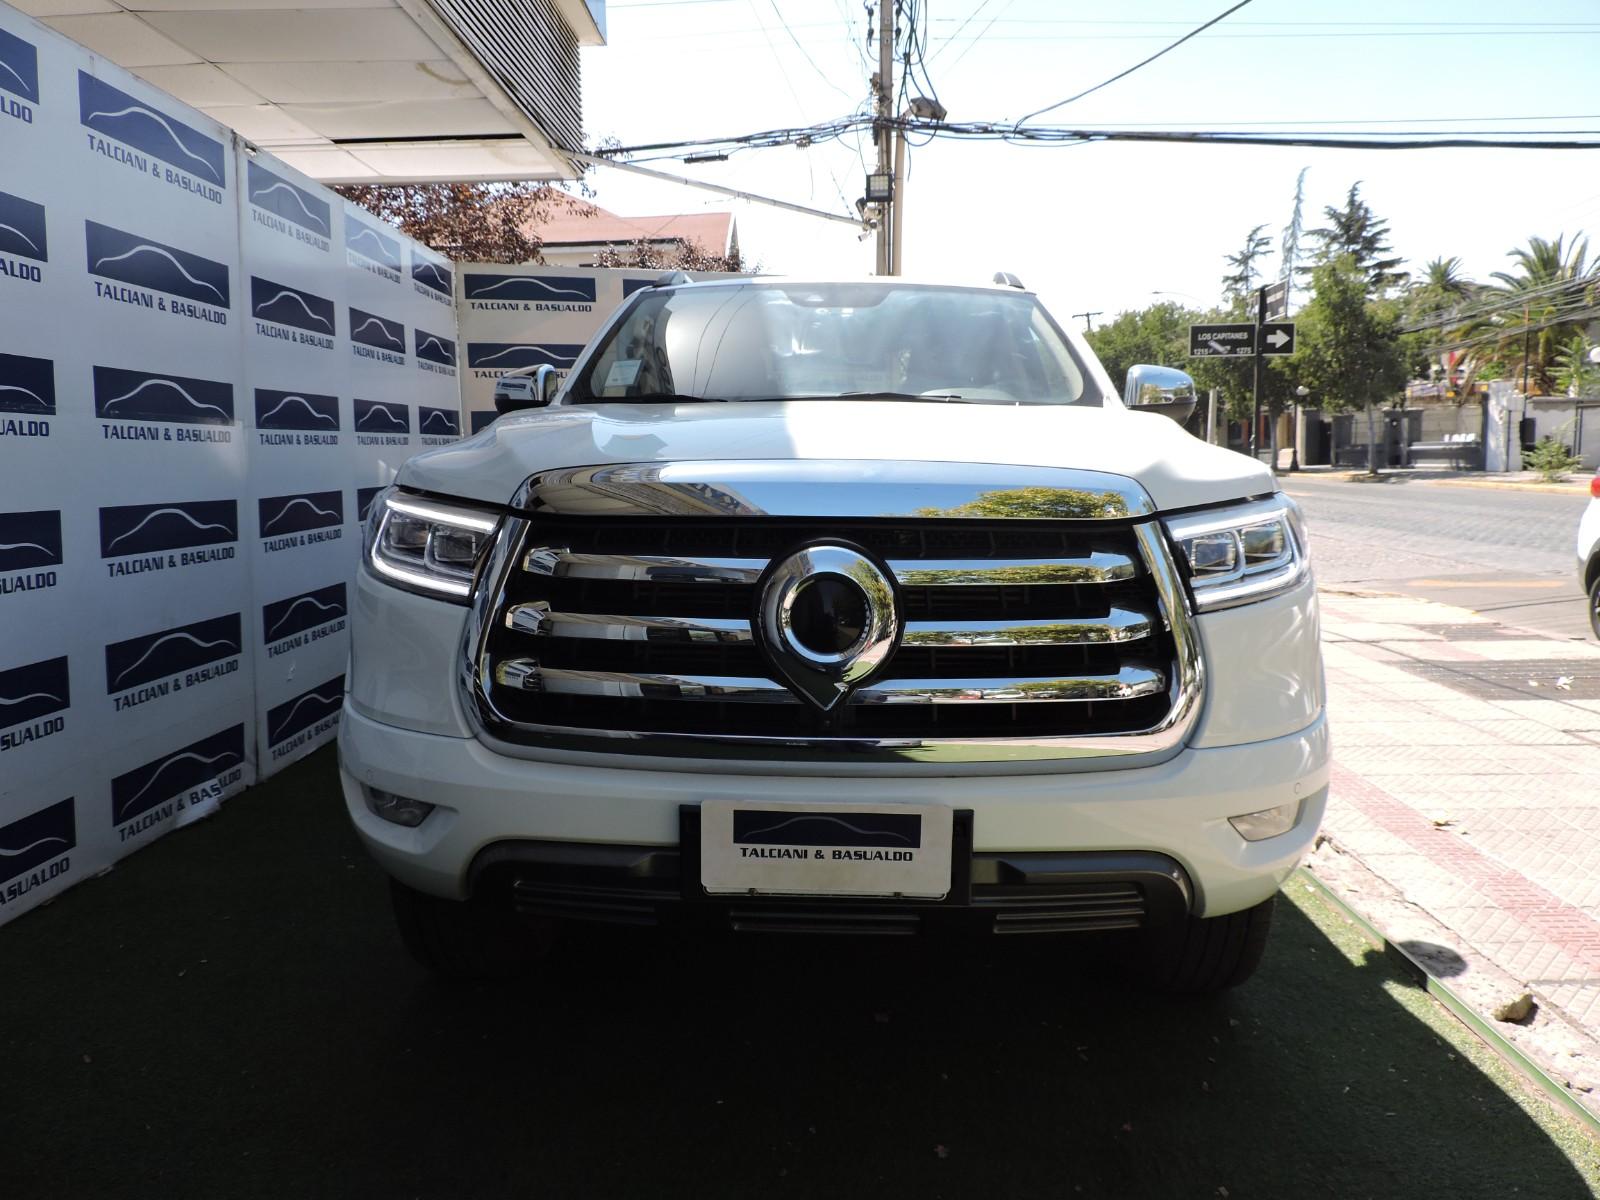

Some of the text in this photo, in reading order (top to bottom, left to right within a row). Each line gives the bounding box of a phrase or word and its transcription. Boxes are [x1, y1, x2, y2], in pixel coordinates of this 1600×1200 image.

[88, 133, 222, 204] TALCIANI & BASUALDO
[95, 281, 226, 325] TALCIANI & BASUALDO
[470, 302, 592, 312] TALCIANI & BASUALDO
[256, 322, 334, 350] TALCIANI & BASUALDO
[1212, 332, 1248, 340] CAPITANES
[102, 424, 231, 443] TALCIANI & BASUALDO
[259, 433, 338, 446] TALCIANI & BASUALDO
[263, 528, 342, 553] TALCIANI & BASUALDO
[107, 546, 235, 578] TALCIANI & BASUALDO
[0, 572, 56, 595] UALDO
[268, 620, 346, 658] TALCIANI & BASUALDO
[113, 659, 239, 712] TALCIANI & BASUALDO
[118, 803, 173, 843] TALCIANI
[176, 798, 186, 812] &
[740, 847, 913, 862] TALCIANI & BASUALDO
